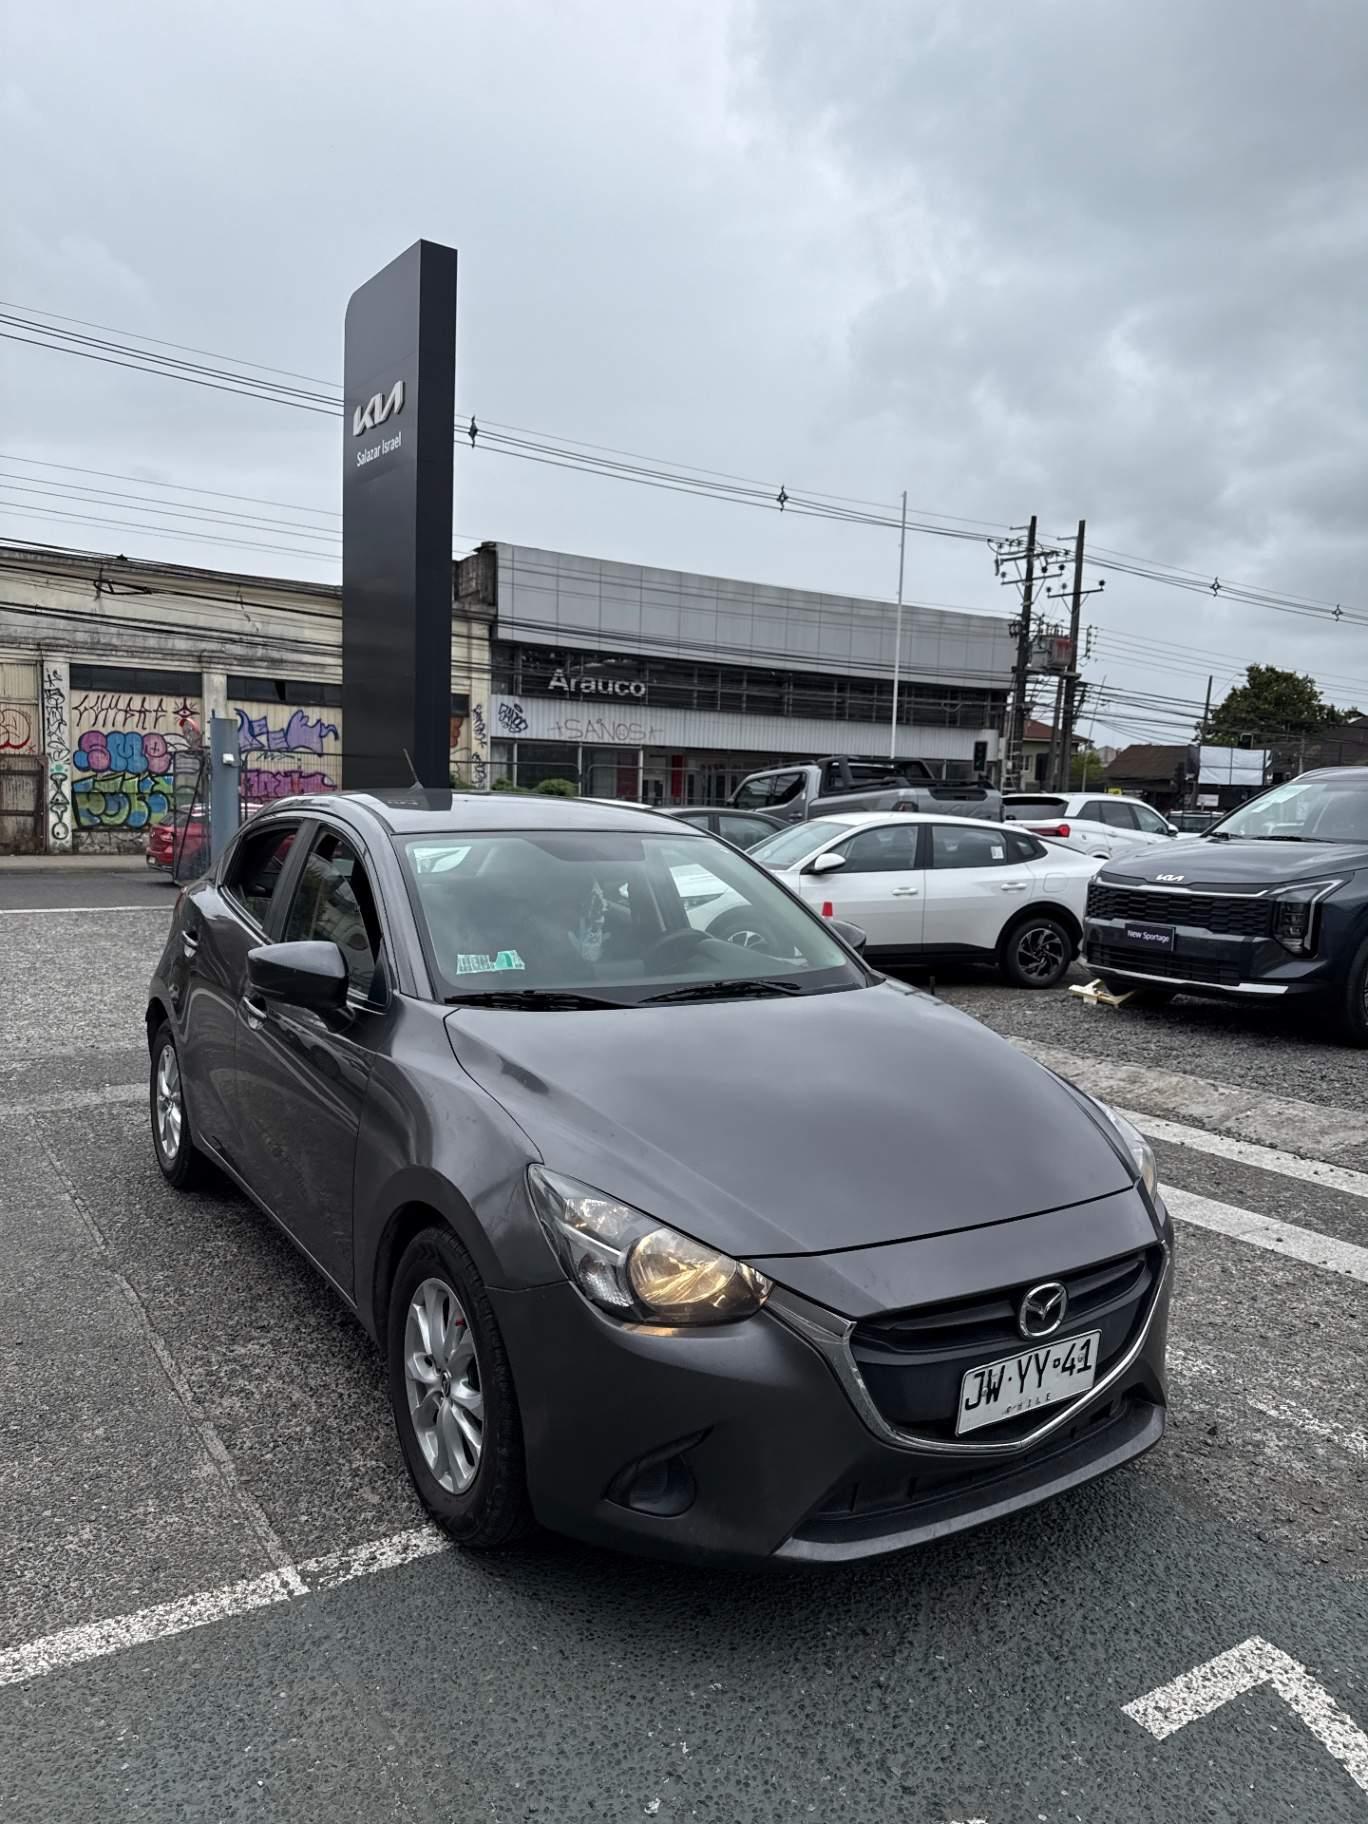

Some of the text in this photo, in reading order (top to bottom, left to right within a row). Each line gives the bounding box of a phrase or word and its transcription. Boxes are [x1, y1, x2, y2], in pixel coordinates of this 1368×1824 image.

[352, 380, 405, 437] KIA
[356, 431, 402, 467] Salazar Israel
[547, 668, 646, 697] Arauco
[1155, 873, 1184, 881] KIA
[1127, 930, 1169, 943] New Sportage
